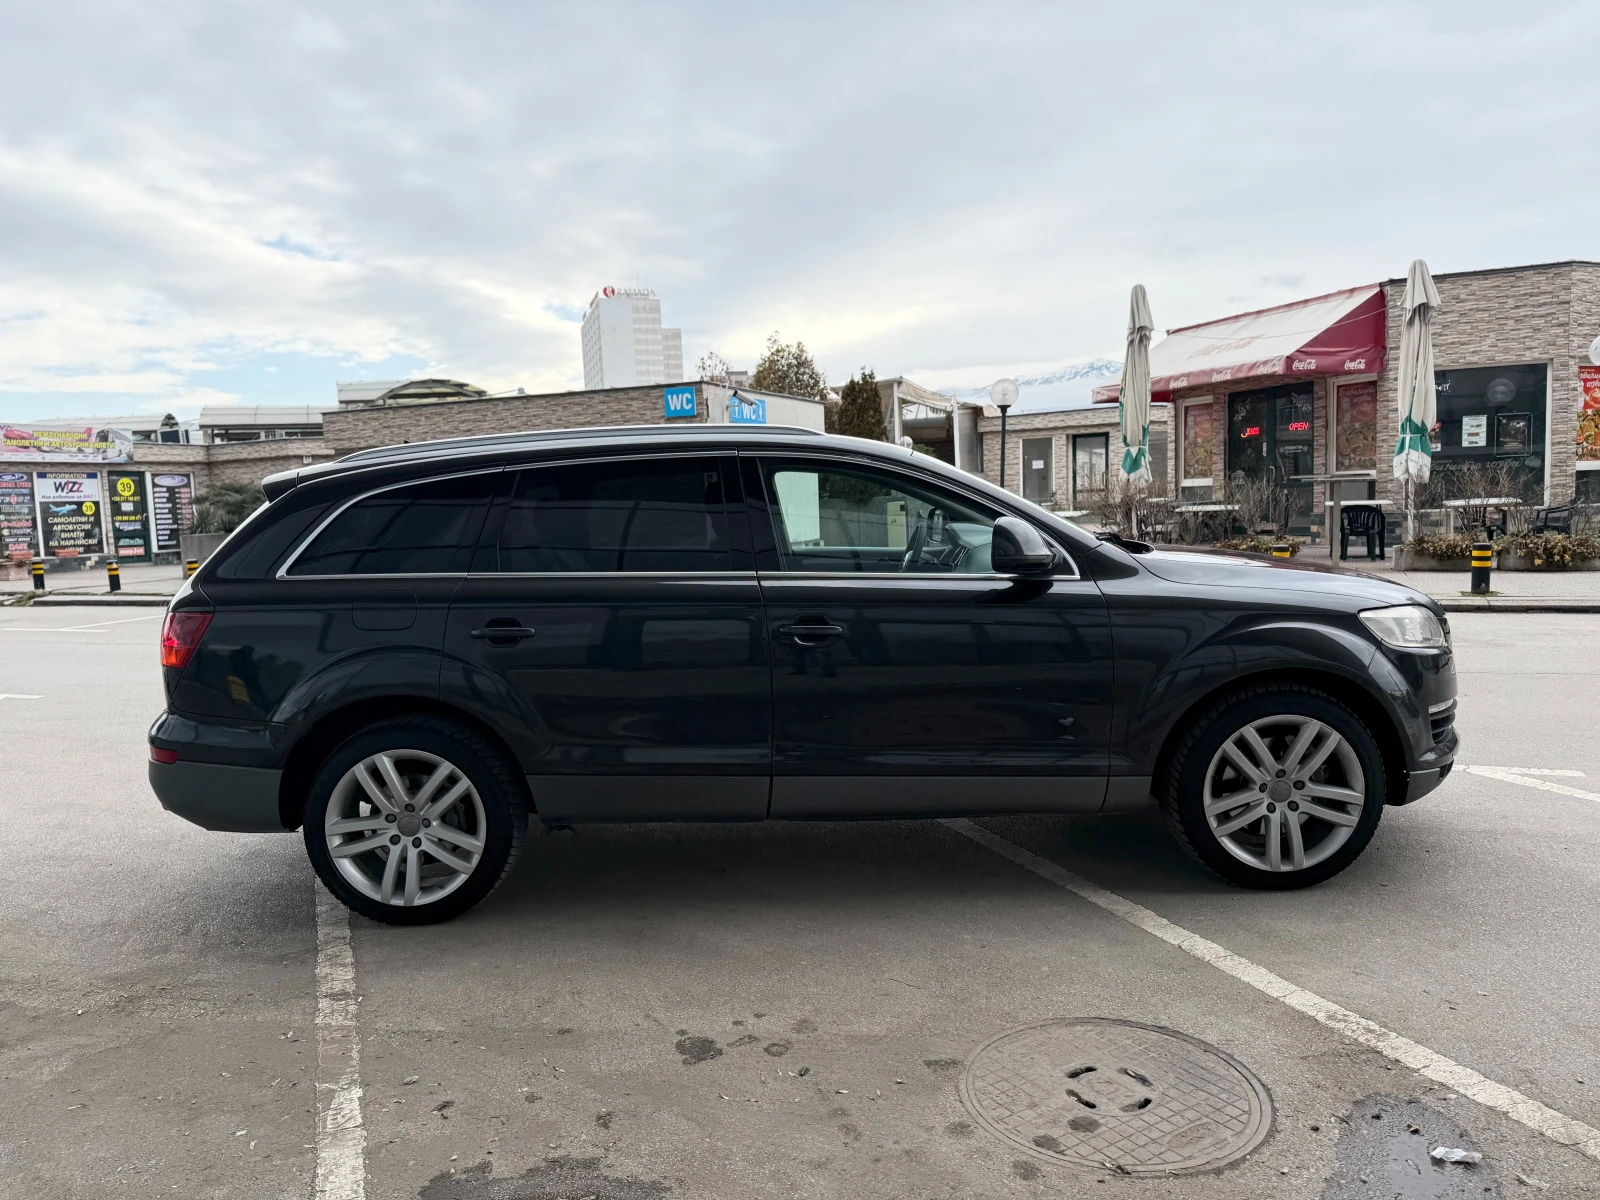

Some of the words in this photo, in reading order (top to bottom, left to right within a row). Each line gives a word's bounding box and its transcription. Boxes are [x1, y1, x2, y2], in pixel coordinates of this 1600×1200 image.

[667, 393, 692, 411] WC
[741, 402, 757, 420] WC
[1289, 422, 1309, 430] OPEN
[52, 441, 89, 449] АВТОБУСНИ
[54, 480, 83, 494] WIZZ
[120, 482, 132, 493] 39
